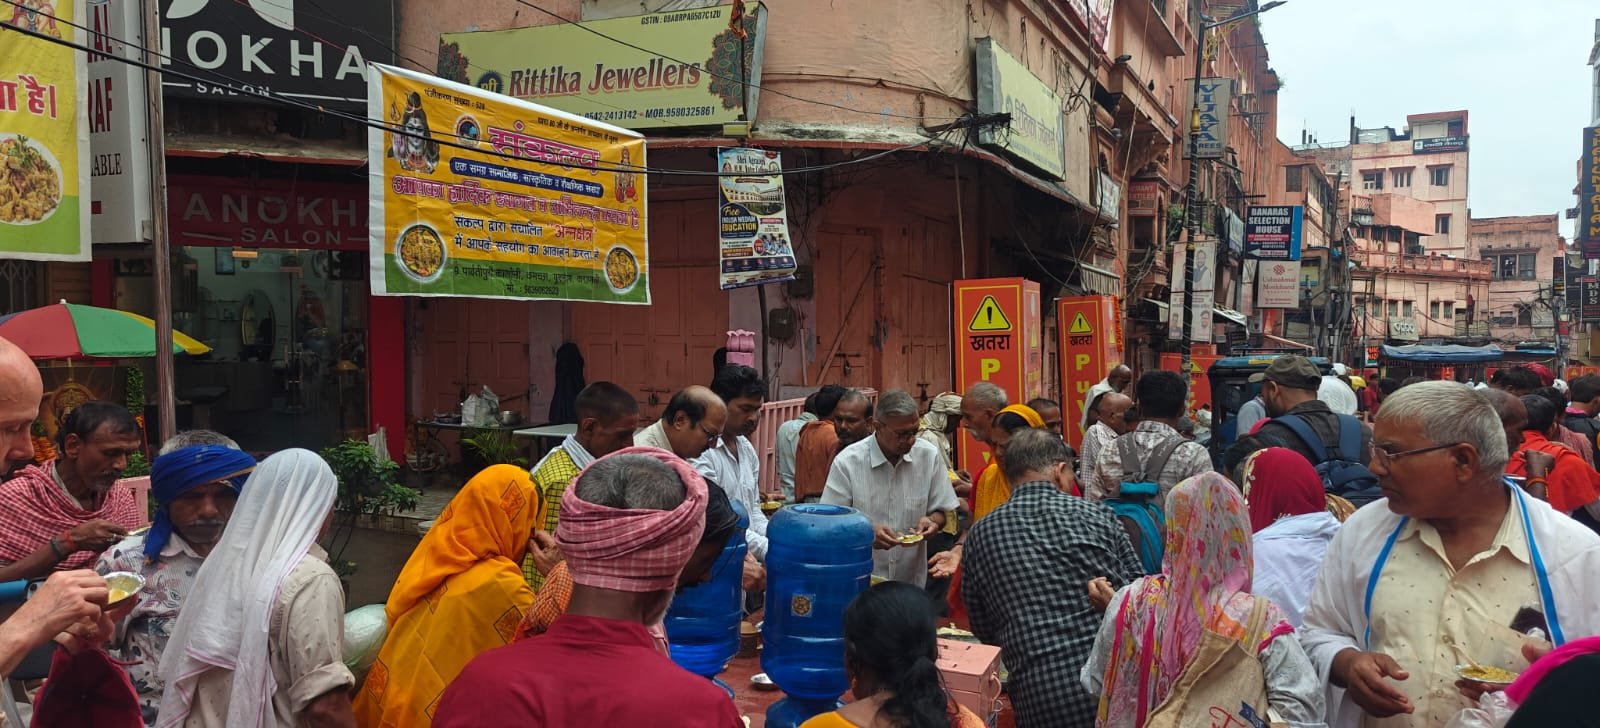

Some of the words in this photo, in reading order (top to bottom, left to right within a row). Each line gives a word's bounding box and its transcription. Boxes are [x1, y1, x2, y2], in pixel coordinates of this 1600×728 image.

[641, 16, 659, 25] GSTIN
[509, 65, 582, 98] Rittika
[588, 58, 702, 93] Jewellers
[487, 119, 600, 175] संकल्प
[454, 161, 467, 172] एक
[393, 174, 445, 199] आपका
[182, 193, 369, 228] ANOKH
[454, 213, 484, 231] संकल्प
[488, 220, 506, 232] द्वारा
[510, 220, 543, 236] संचालित
[721, 223, 757, 233] EDUCATION
[1248, 216, 1291, 225] SELECTION
[240, 227, 341, 245] SALON
[1255, 225, 1282, 234] HOUSE
[454, 232, 463, 248] में
[495, 240, 525, 254] सहयोग
[527, 244, 539, 256] का
[969, 334, 1011, 351] खतरा
[1069, 335, 1093, 346] खतरा
